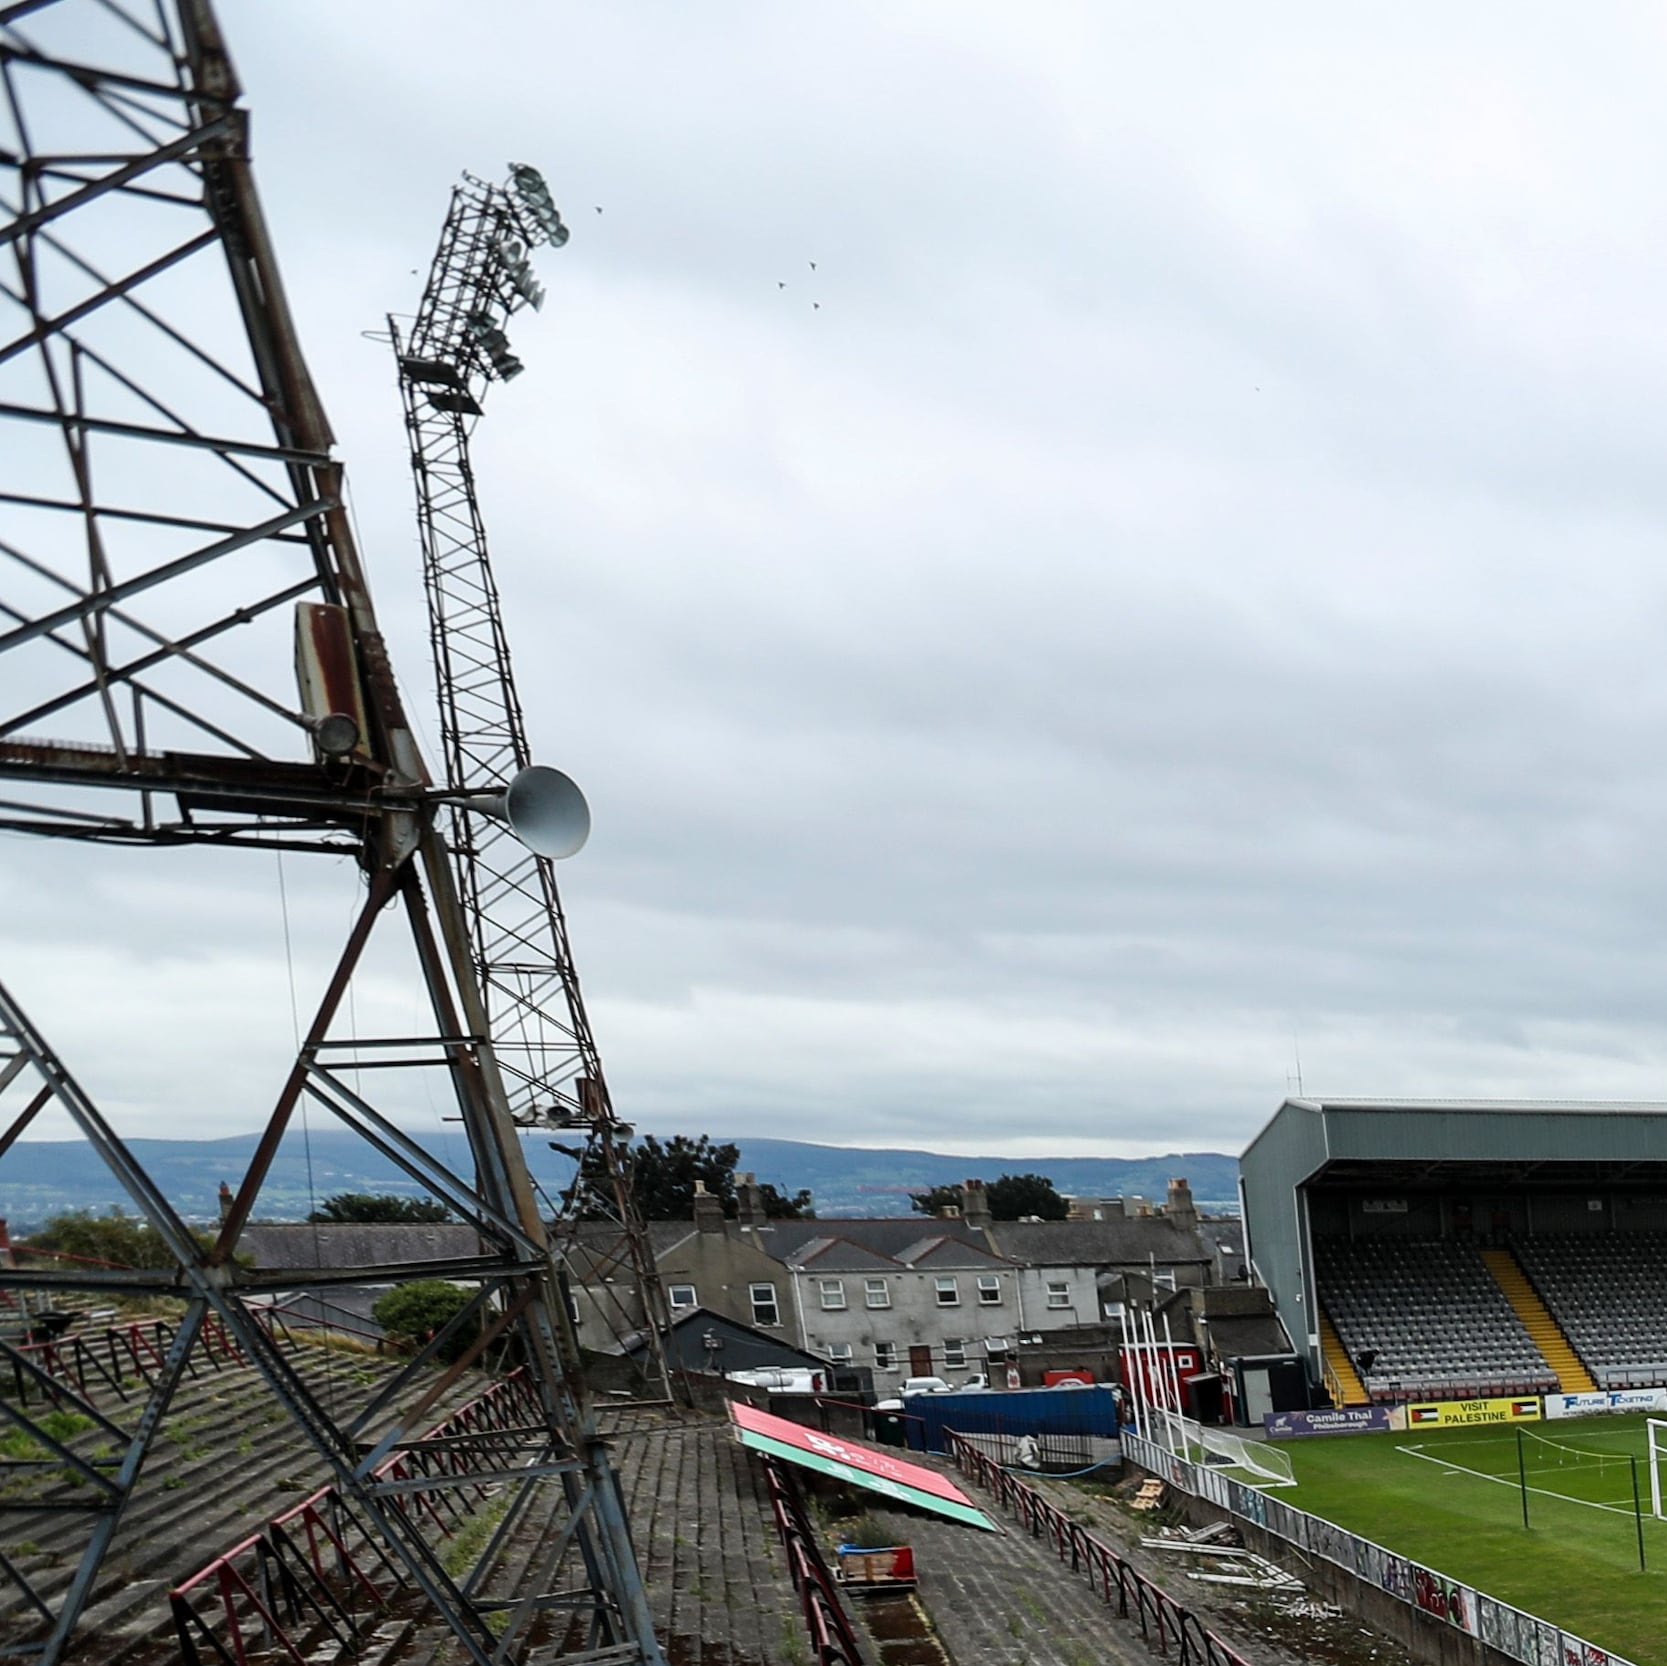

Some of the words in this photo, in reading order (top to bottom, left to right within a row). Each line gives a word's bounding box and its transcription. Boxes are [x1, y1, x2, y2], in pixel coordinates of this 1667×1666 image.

[1461, 1401, 1488, 1412] VISIT
[1562, 1396, 1605, 1409] FUTURE
[1607, 1393, 1653, 1407] TICKETING
[1306, 1412, 1346, 1424] Camile
[1347, 1409, 1373, 1420] Thai
[1444, 1411, 1506, 1424] PALESTINE
